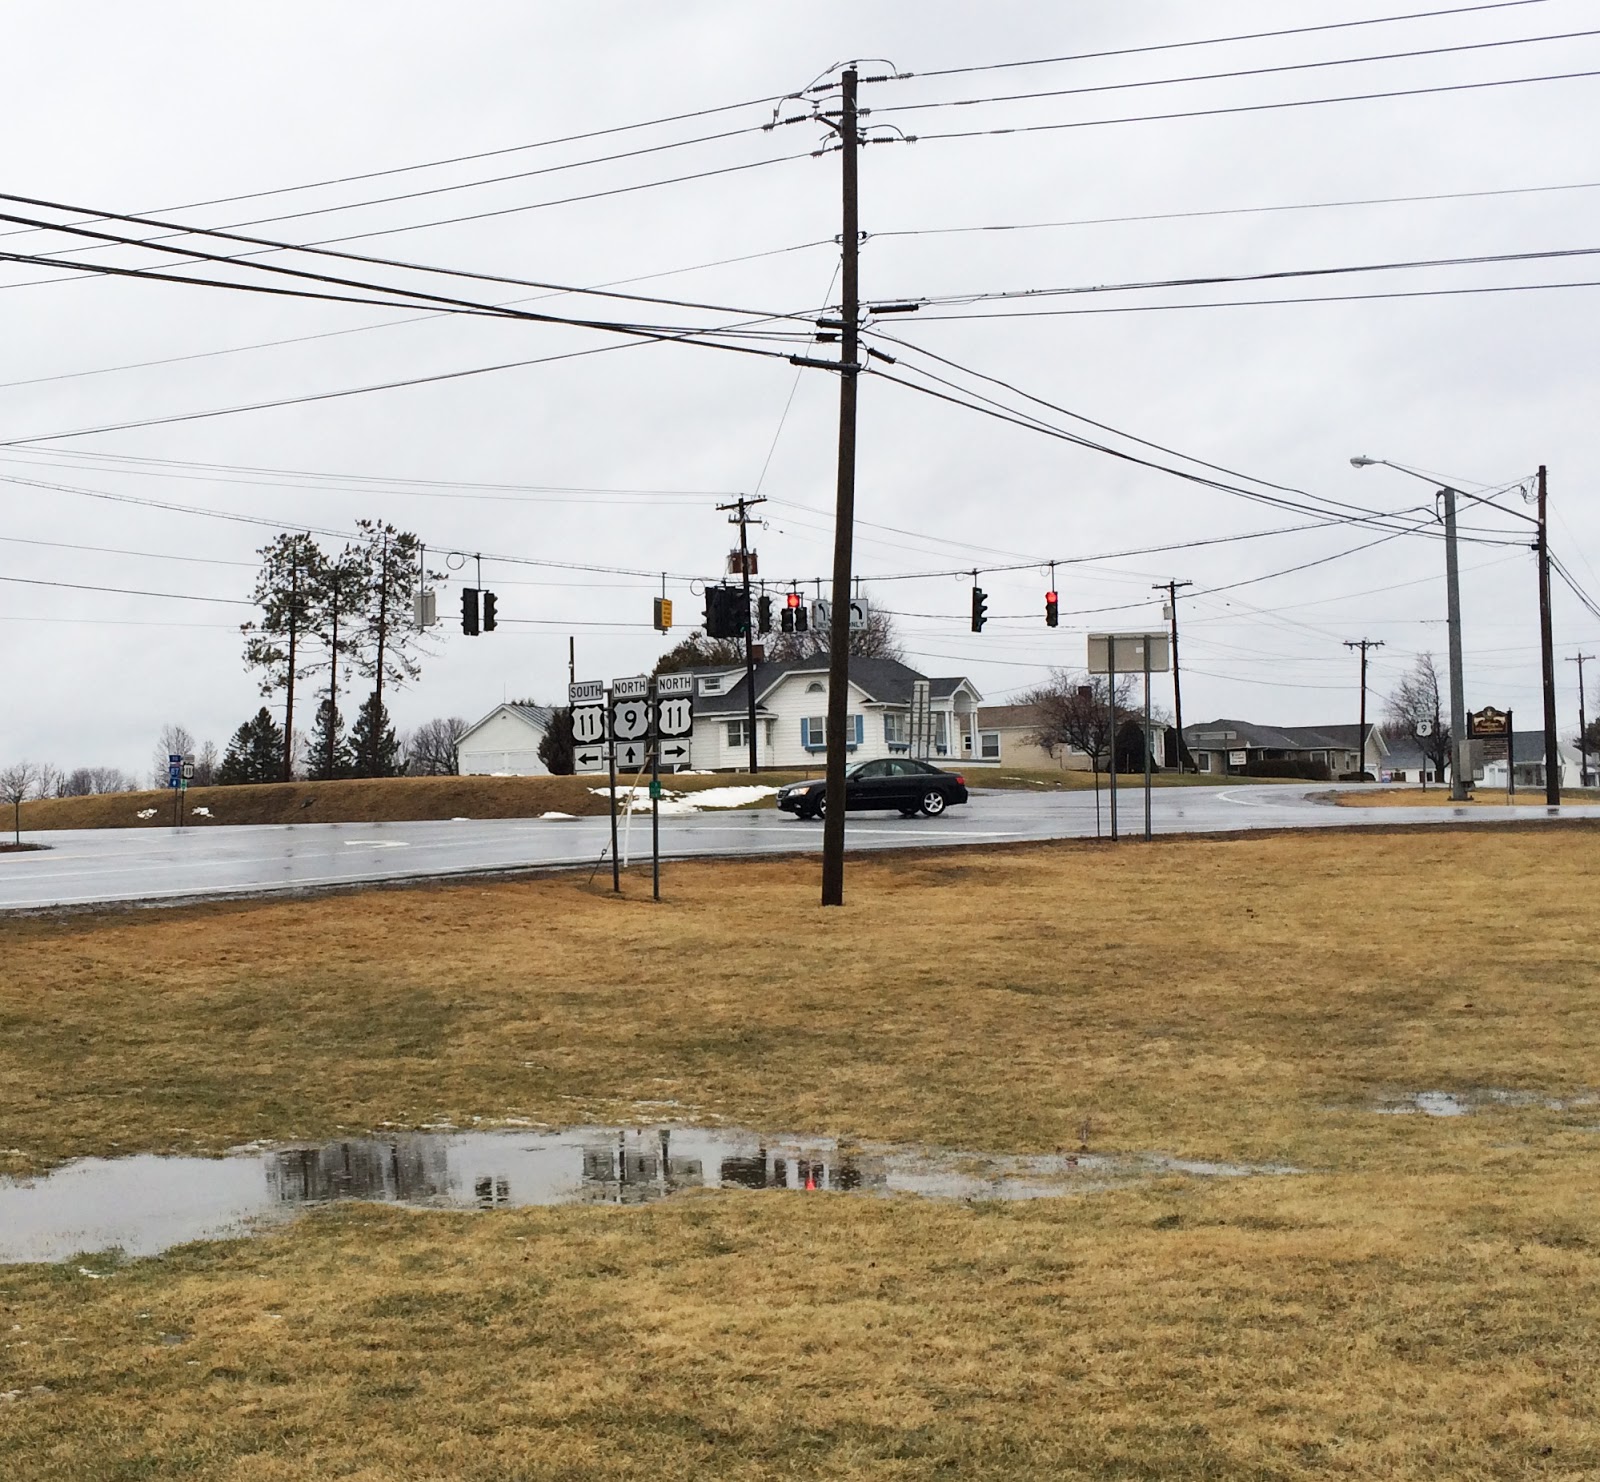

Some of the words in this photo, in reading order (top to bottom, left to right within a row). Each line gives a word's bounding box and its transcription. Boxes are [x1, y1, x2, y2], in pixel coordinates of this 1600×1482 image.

[615, 681, 646, 694] NORTH
[659, 677, 691, 690] NORTH
[570, 686, 602, 698] SOUTH
[624, 710, 637, 731] 9
[668, 706, 682, 728] 11
[580, 714, 594, 736] 11
[1422, 724, 1427, 733] 9
